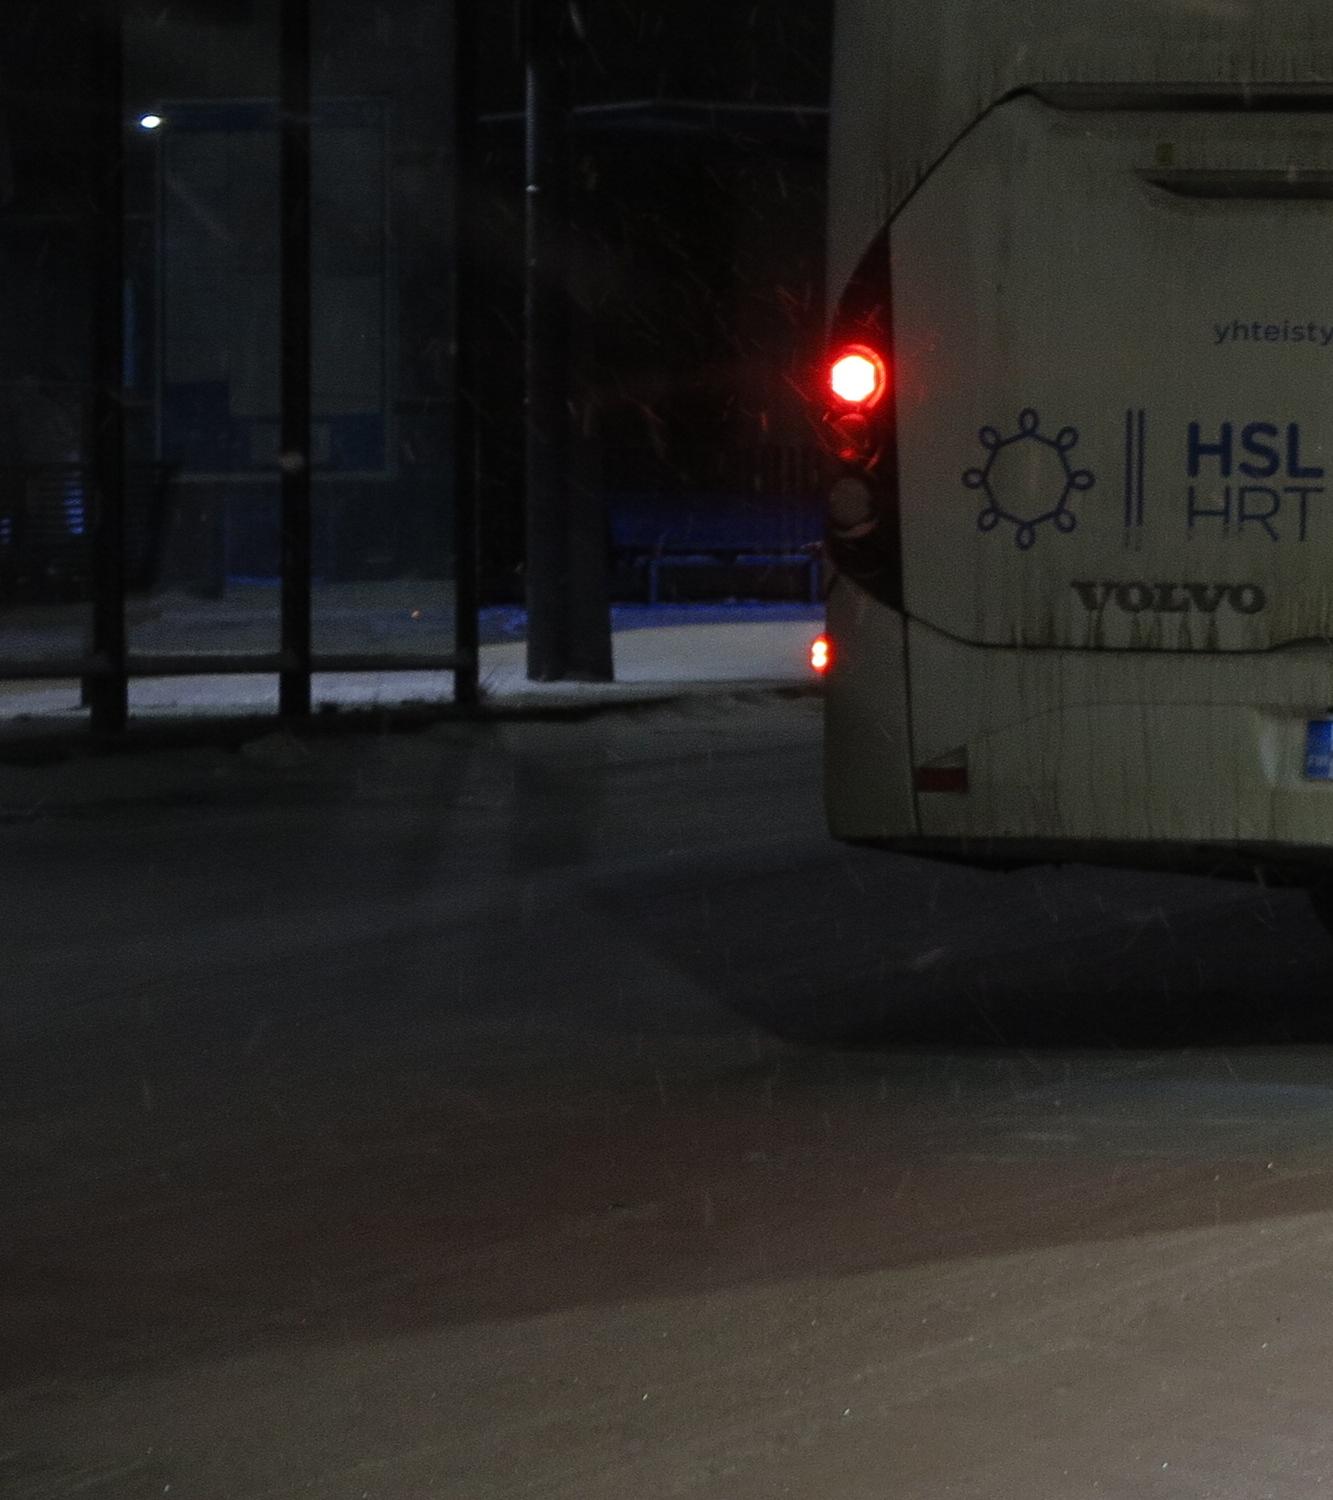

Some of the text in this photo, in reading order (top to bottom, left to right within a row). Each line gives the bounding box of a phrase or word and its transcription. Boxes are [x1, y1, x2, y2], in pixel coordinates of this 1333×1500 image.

[1187, 422, 1324, 479] HSL
[1187, 485, 1324, 542] HRT
[1070, 580, 1267, 615] VOLVO
